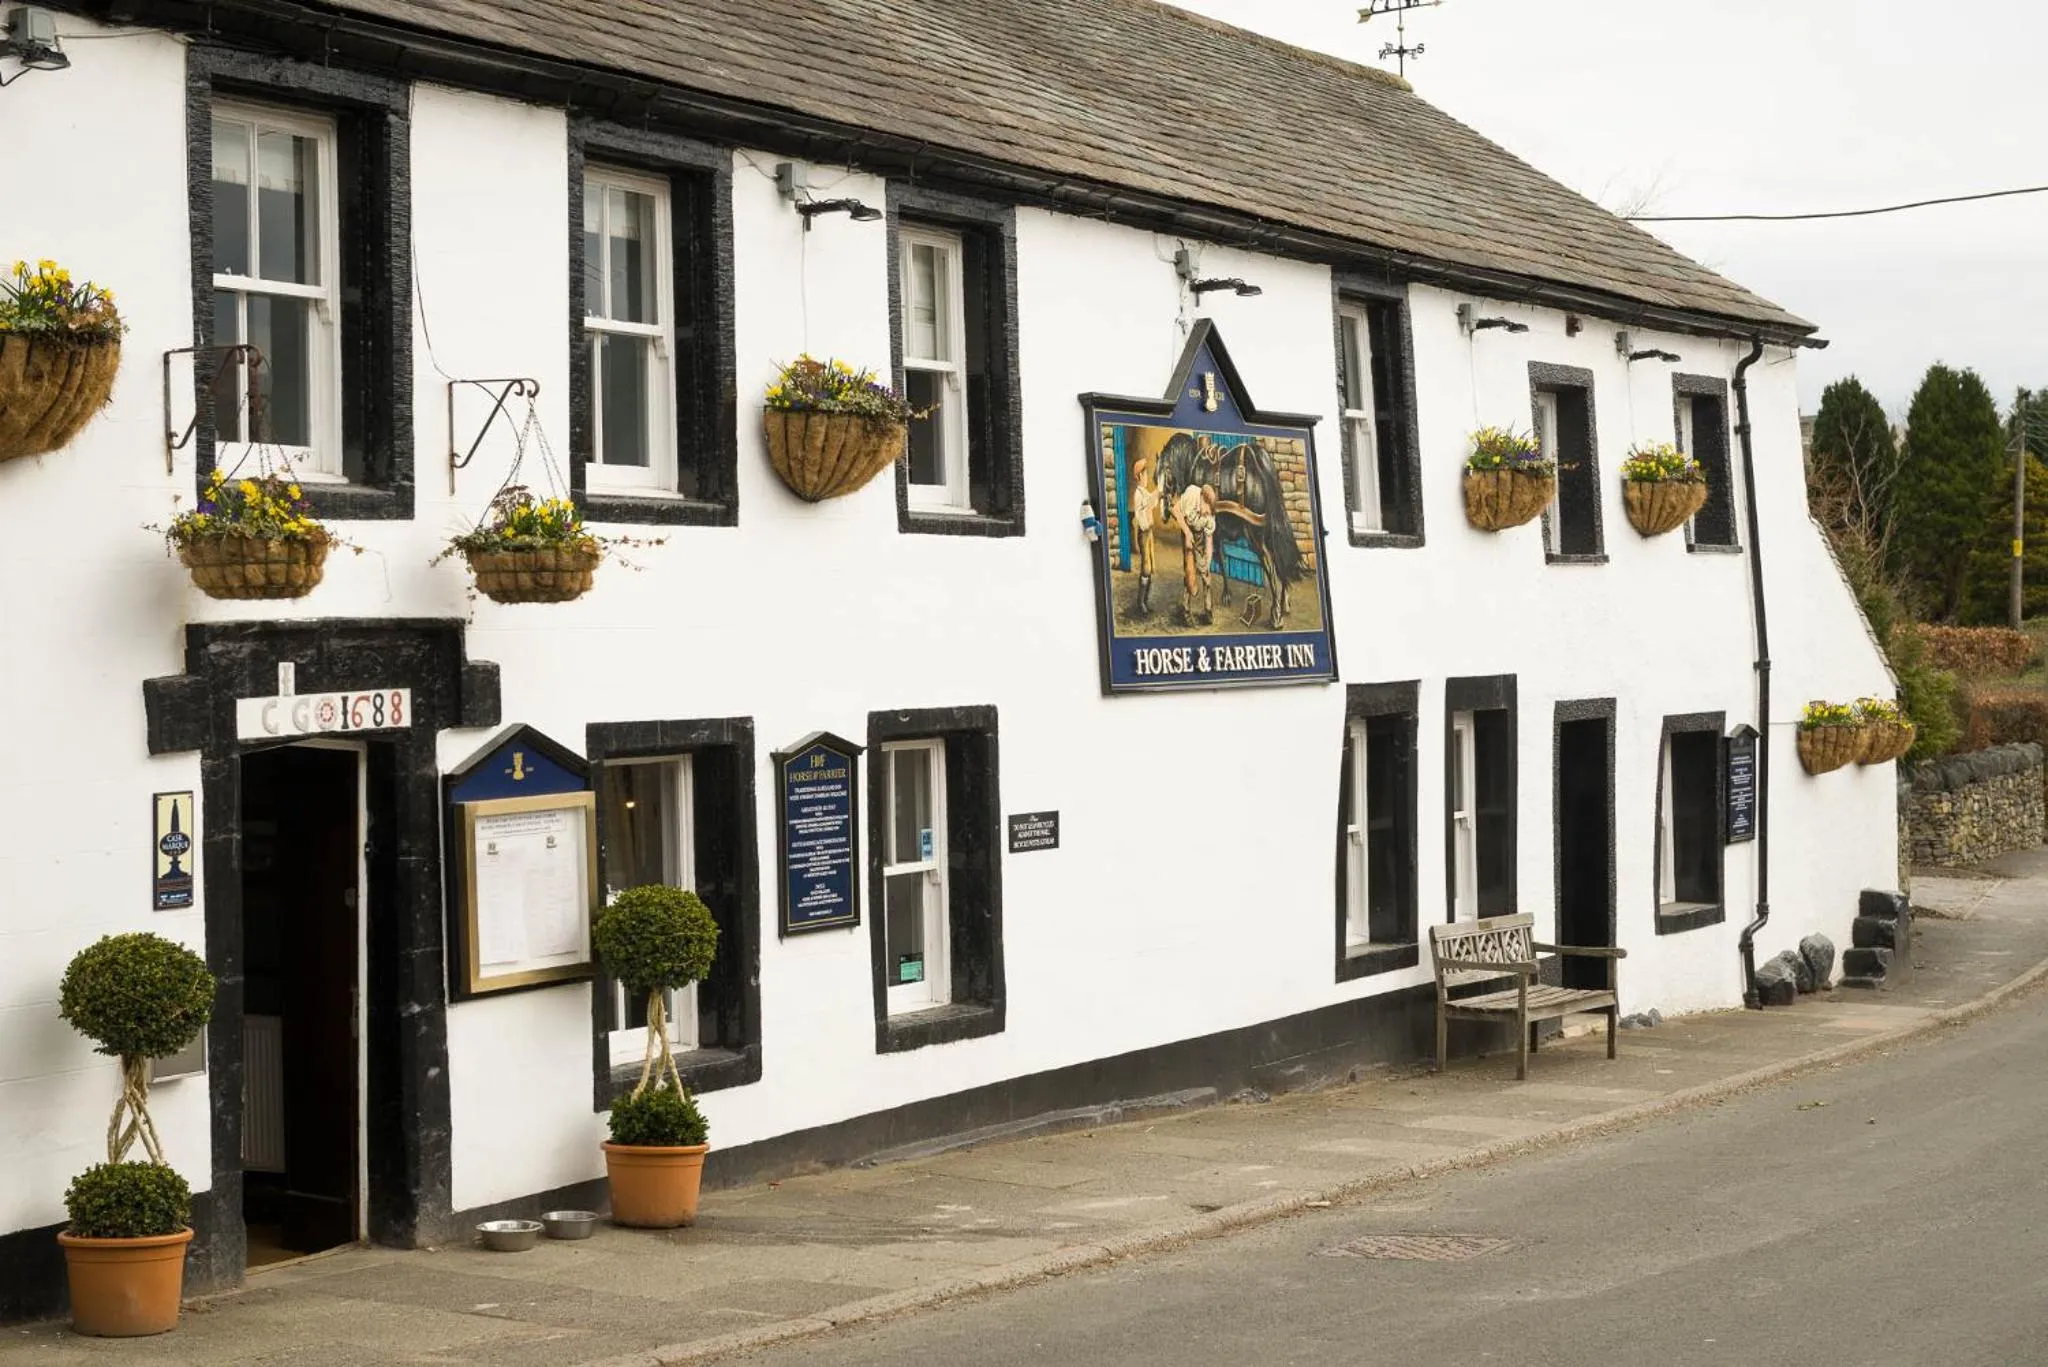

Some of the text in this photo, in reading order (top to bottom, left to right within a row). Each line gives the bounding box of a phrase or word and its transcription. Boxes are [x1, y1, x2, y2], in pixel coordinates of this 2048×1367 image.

[1135, 643, 1316, 676] HORSE & FARRIER INN
